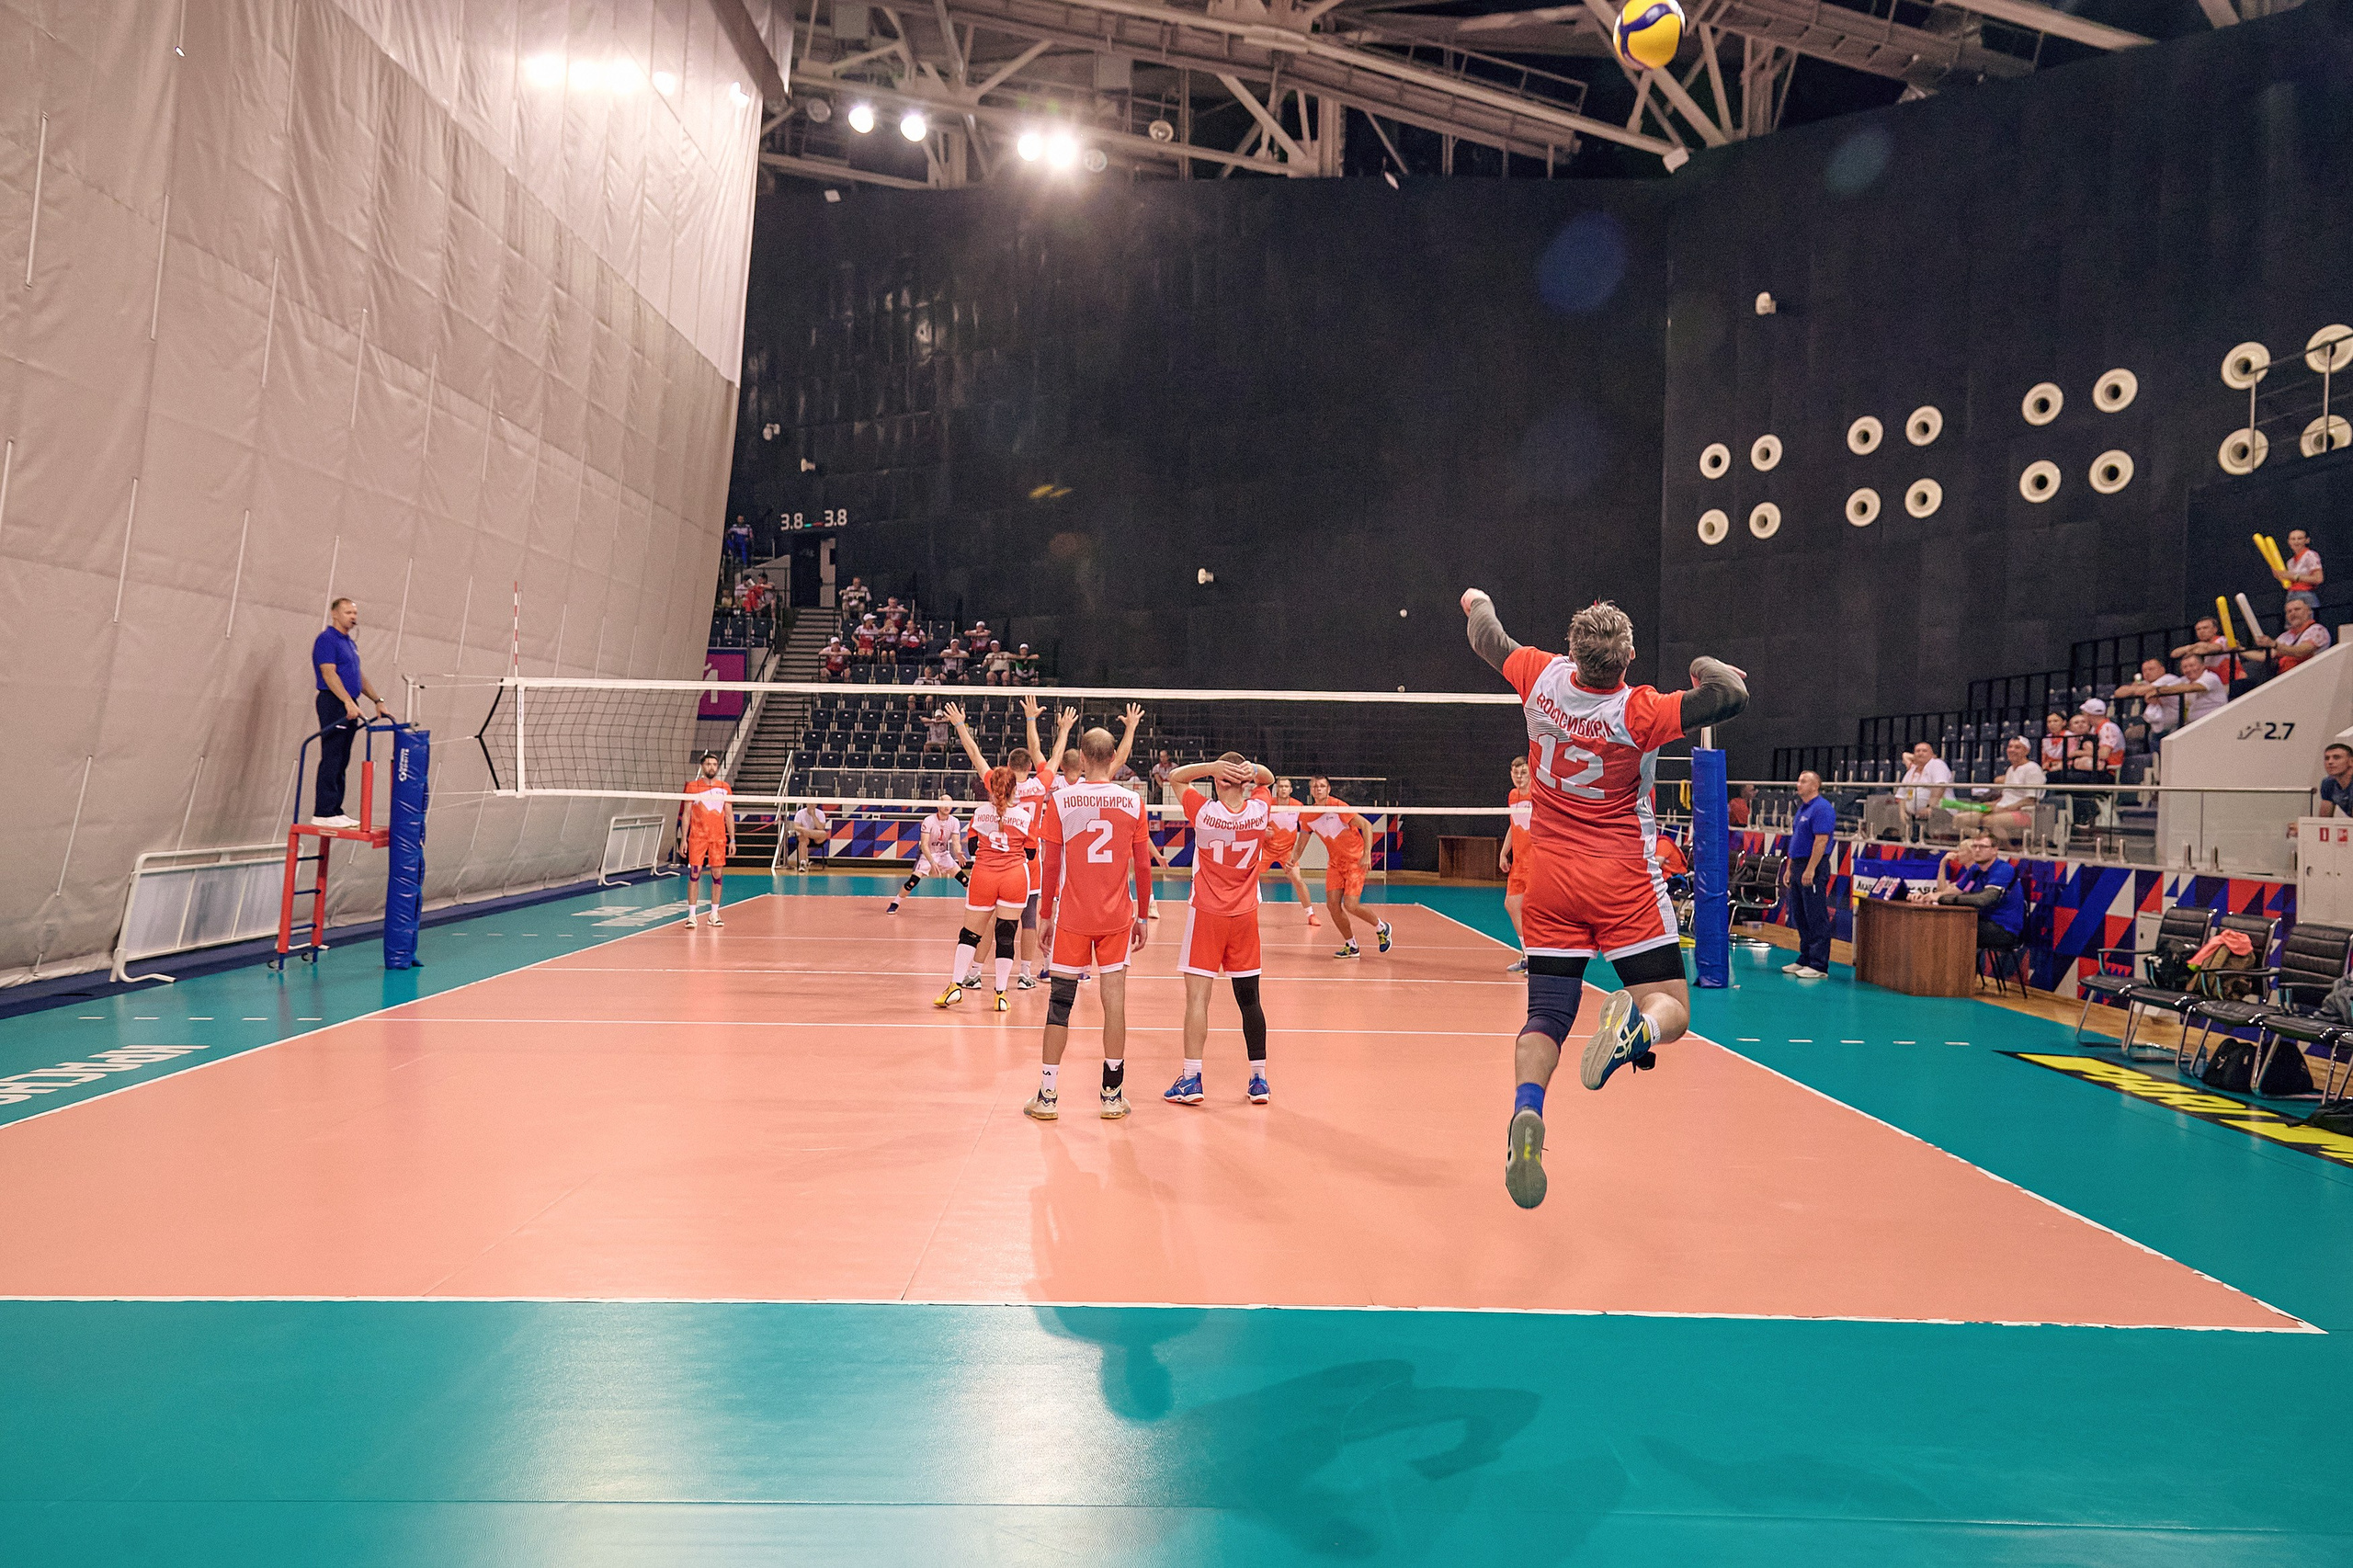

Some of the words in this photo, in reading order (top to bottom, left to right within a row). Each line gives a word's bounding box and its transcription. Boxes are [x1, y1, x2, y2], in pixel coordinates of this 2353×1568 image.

[780, 512, 804, 530] 3.8
[824, 508, 847, 527] 3.8
[2264, 722, 2296, 740] 2.7
[1536, 733, 1606, 800] 12
[1063, 795, 1134, 809] НОВОСИБИРСК
[977, 813, 1025, 828] НОВОСБИРСК
[1202, 813, 1265, 831] НОВОСИБИРСК
[1086, 819, 1114, 863] 2
[1209, 837, 1259, 869] 17
